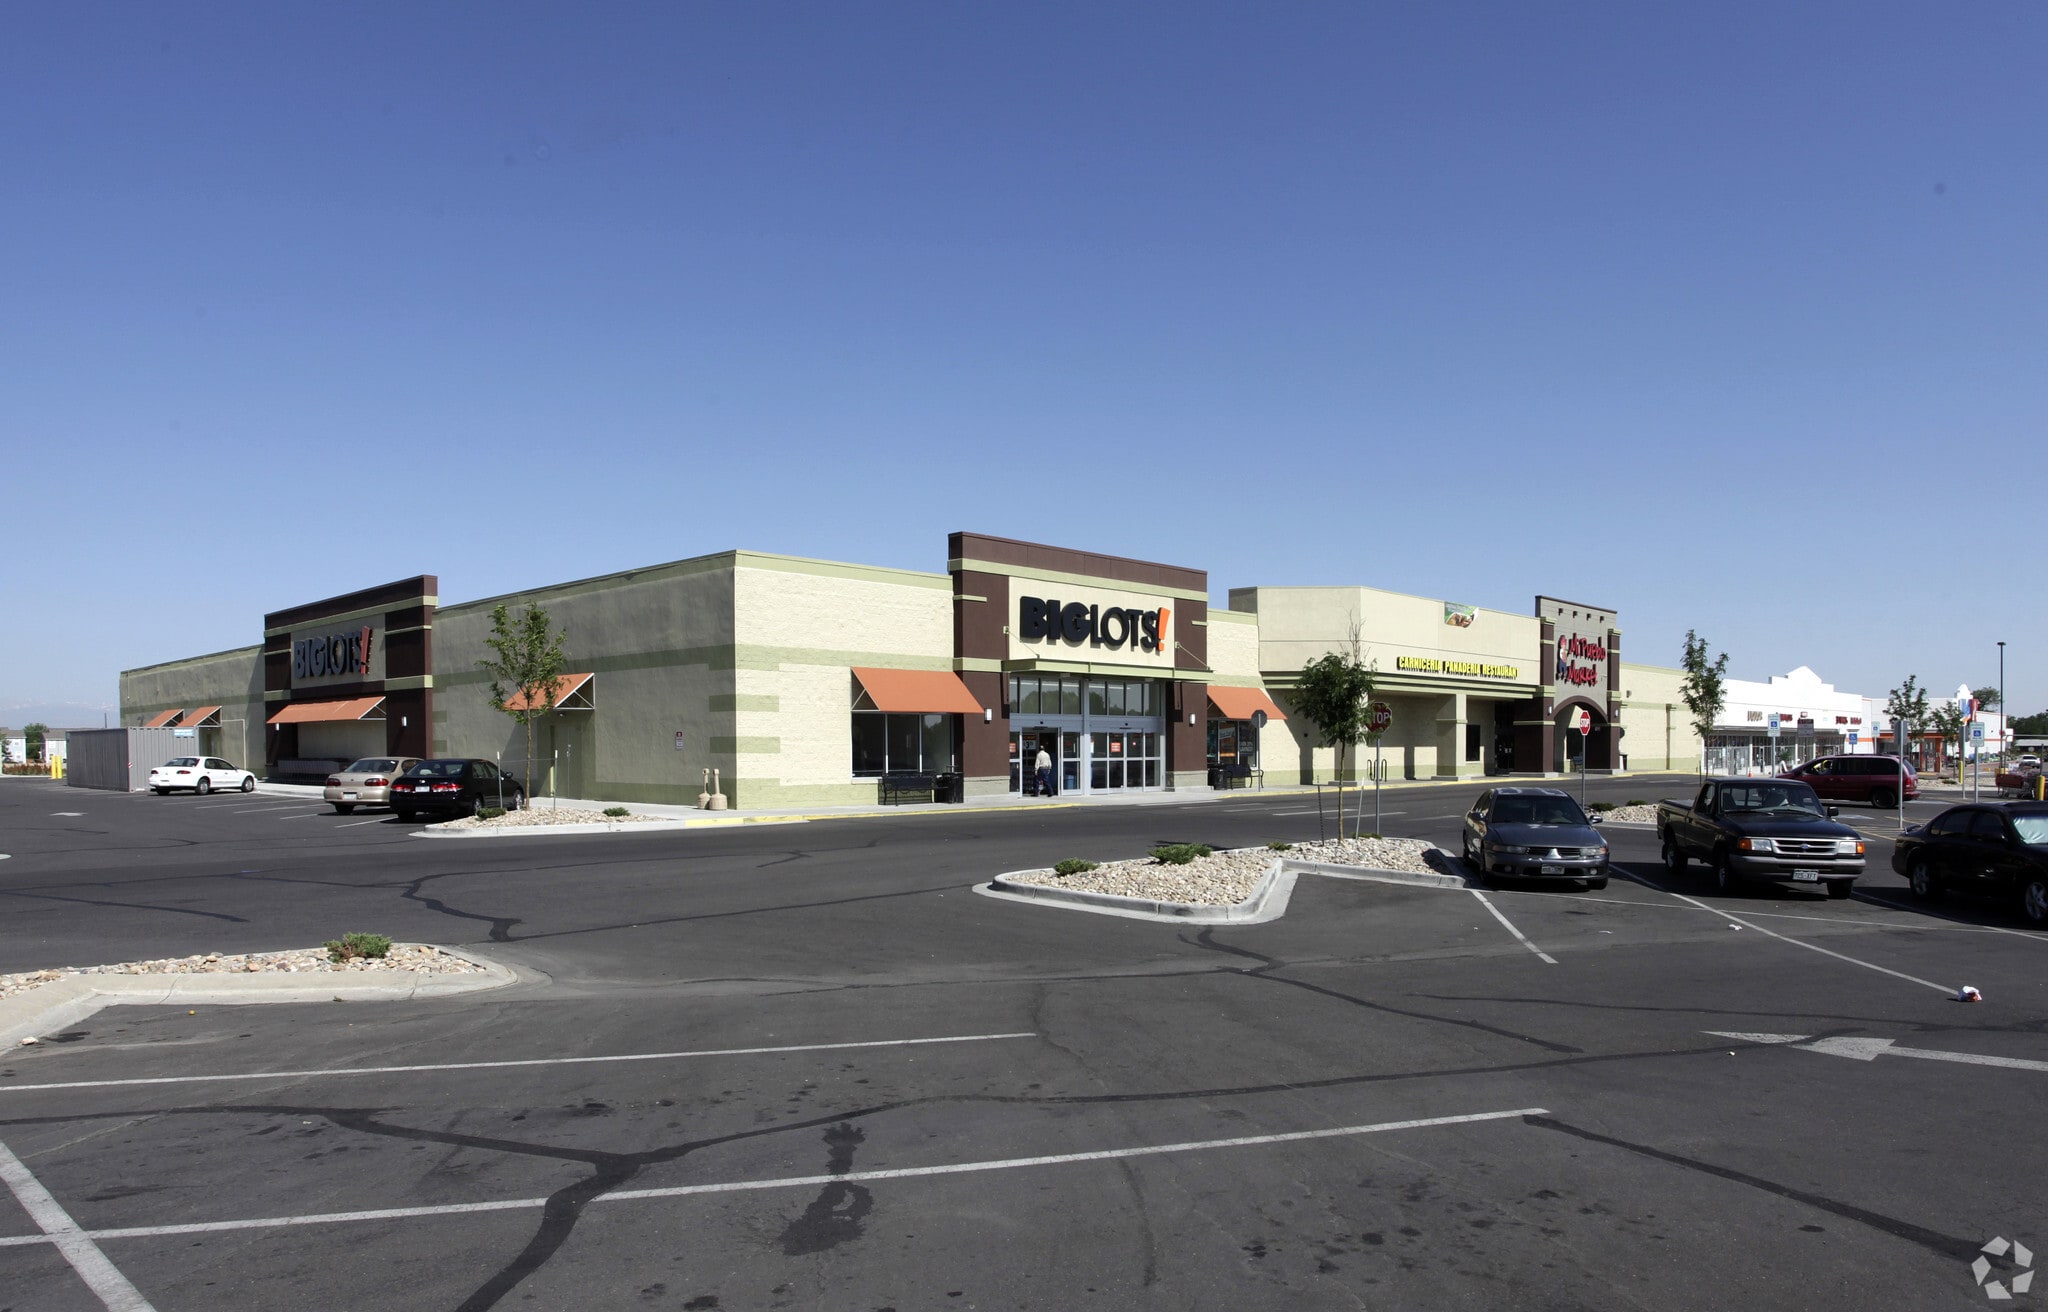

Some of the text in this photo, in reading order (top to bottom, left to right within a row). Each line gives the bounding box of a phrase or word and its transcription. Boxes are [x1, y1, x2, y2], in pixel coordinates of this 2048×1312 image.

[1398, 656, 1520, 678] CARNICERIA PANADERIA RESTAURANT
